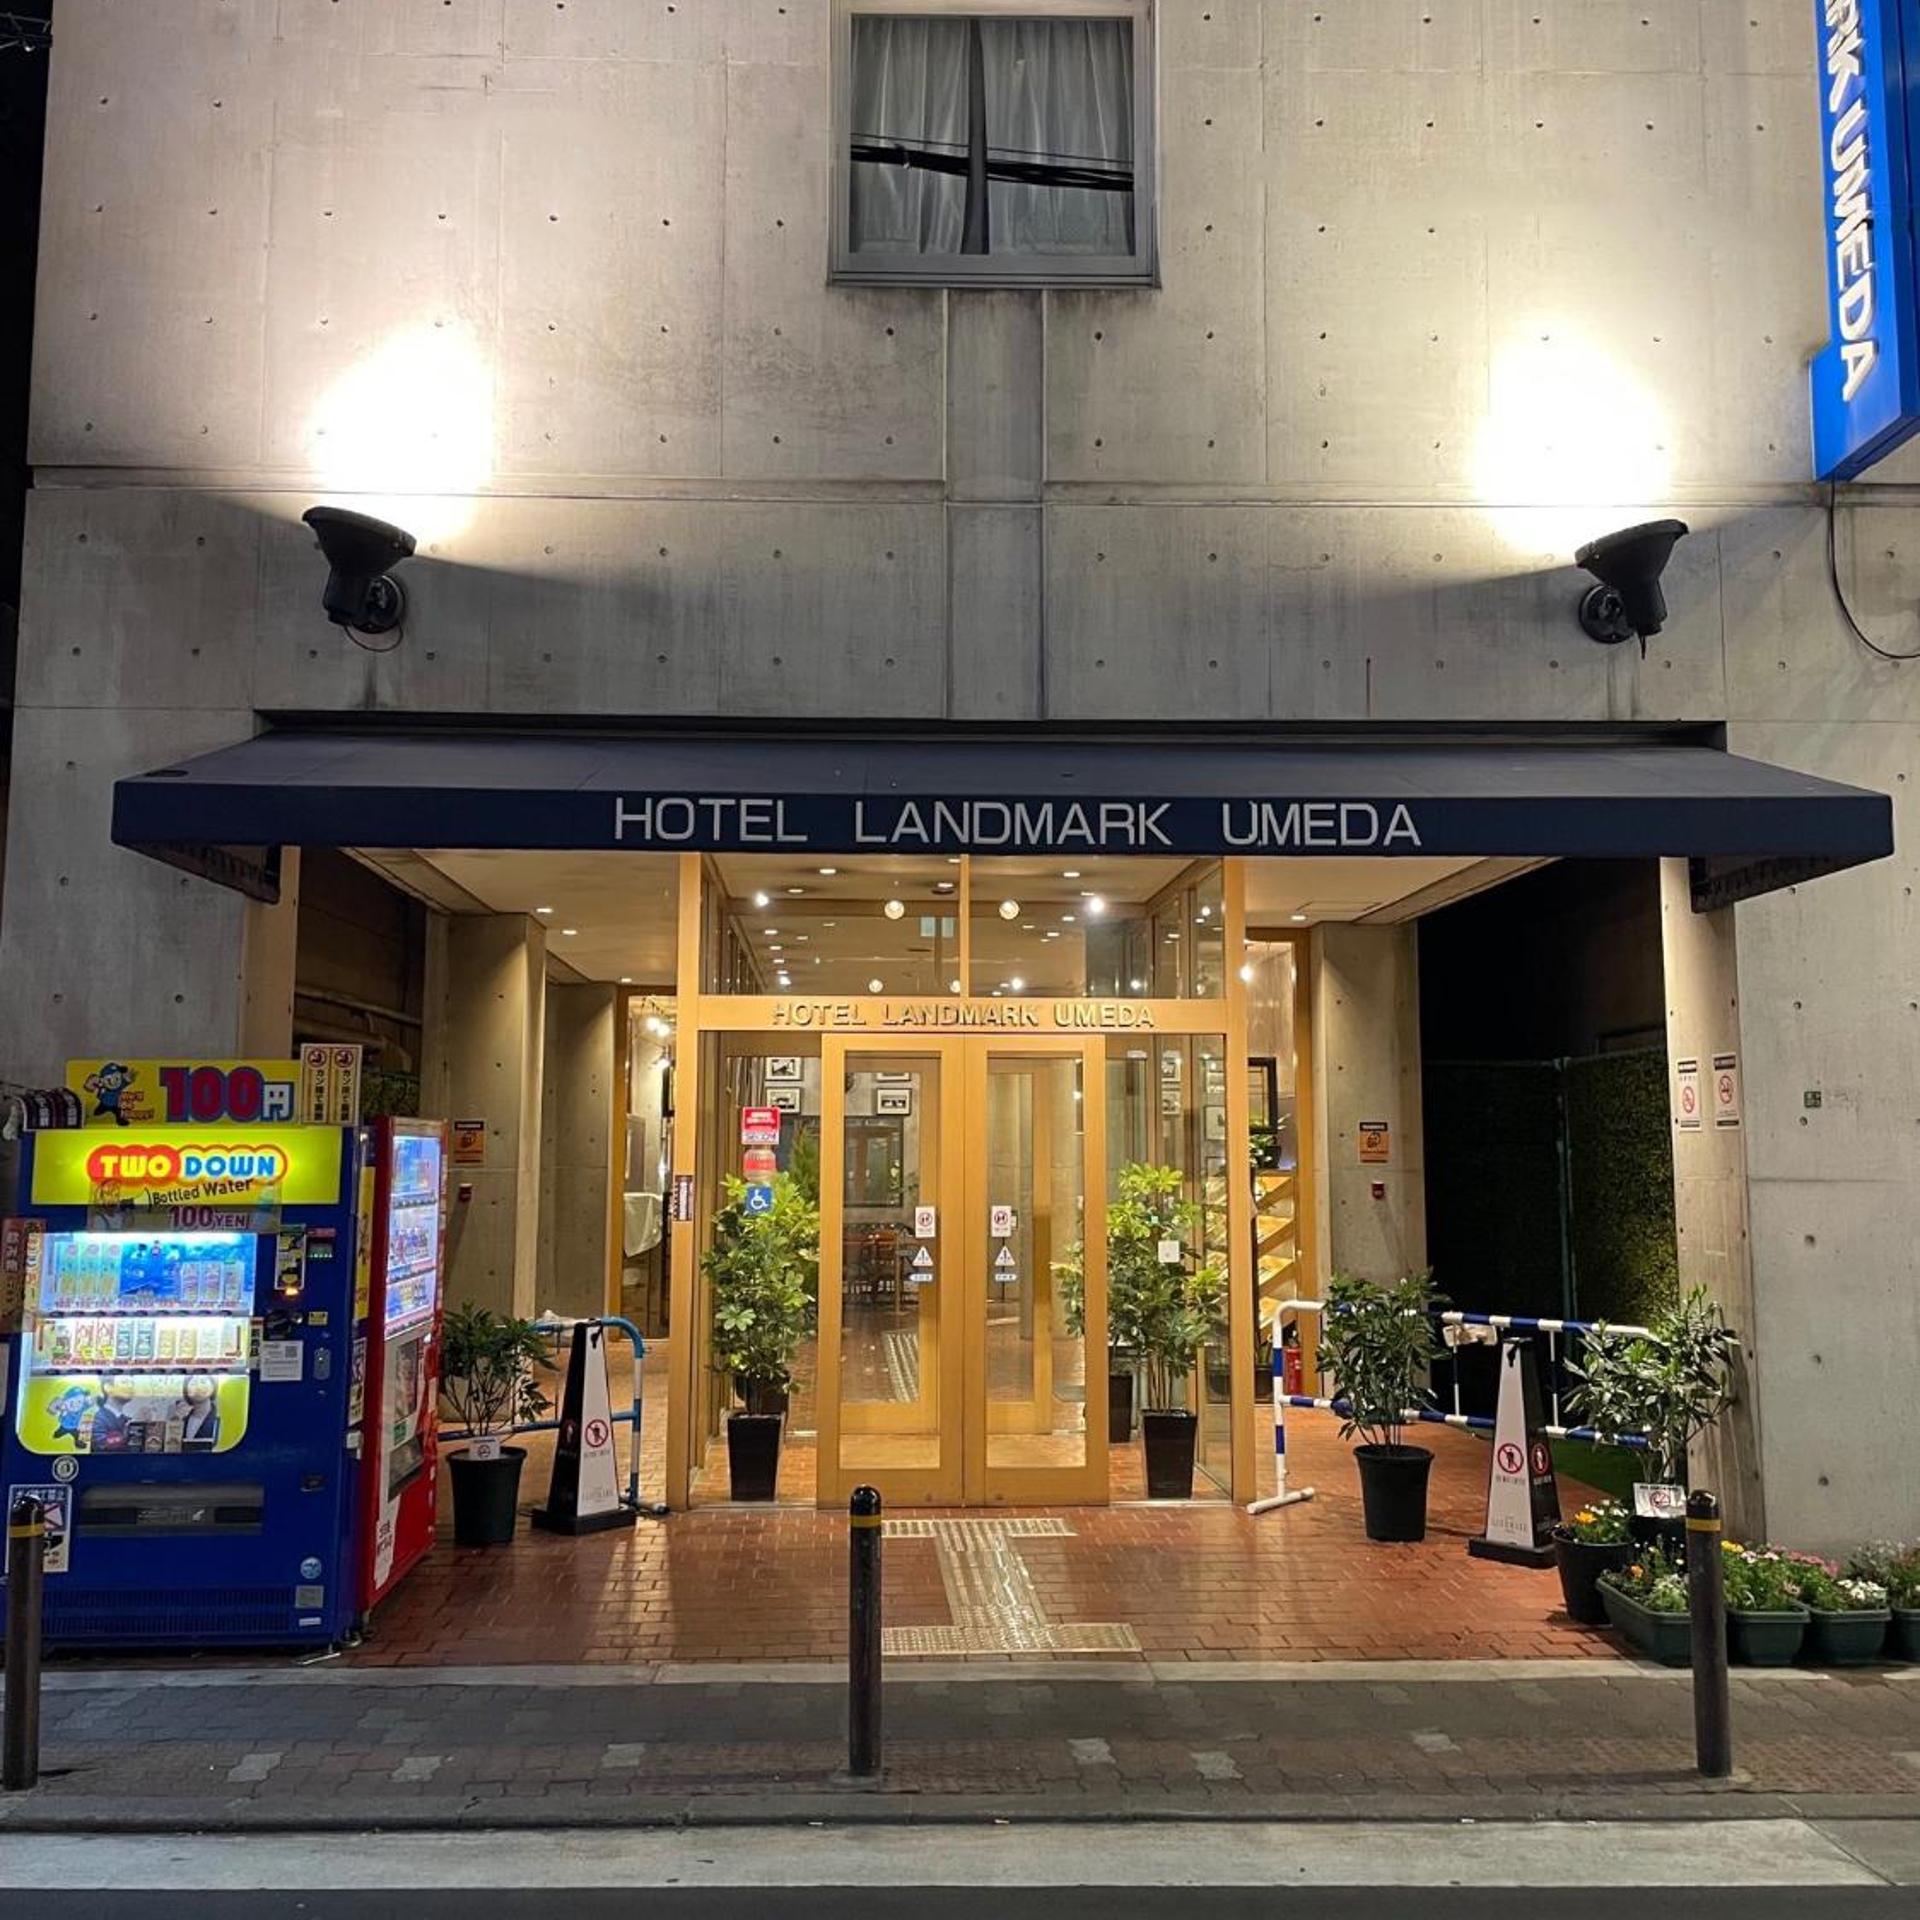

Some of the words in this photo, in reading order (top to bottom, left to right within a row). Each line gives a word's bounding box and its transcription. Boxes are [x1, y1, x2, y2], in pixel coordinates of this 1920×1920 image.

[1823, 0, 1863, 113] RK
[1831, 98, 1877, 402] UMEDA
[615, 797, 808, 842] HOTEL
[855, 801, 1173, 845] LANDMARK
[1222, 801, 1422, 846] UMEDA
[773, 1003, 868, 1027] HOTEL
[882, 1003, 1040, 1027] LANDMARK
[1053, 1003, 1155, 1027] UMEDA
[100, 1155, 172, 1178] TWO
[184, 1155, 275, 1178] DOWN
[152, 1185, 200, 1205] Bottled
[202, 1178, 253, 1197] Water
